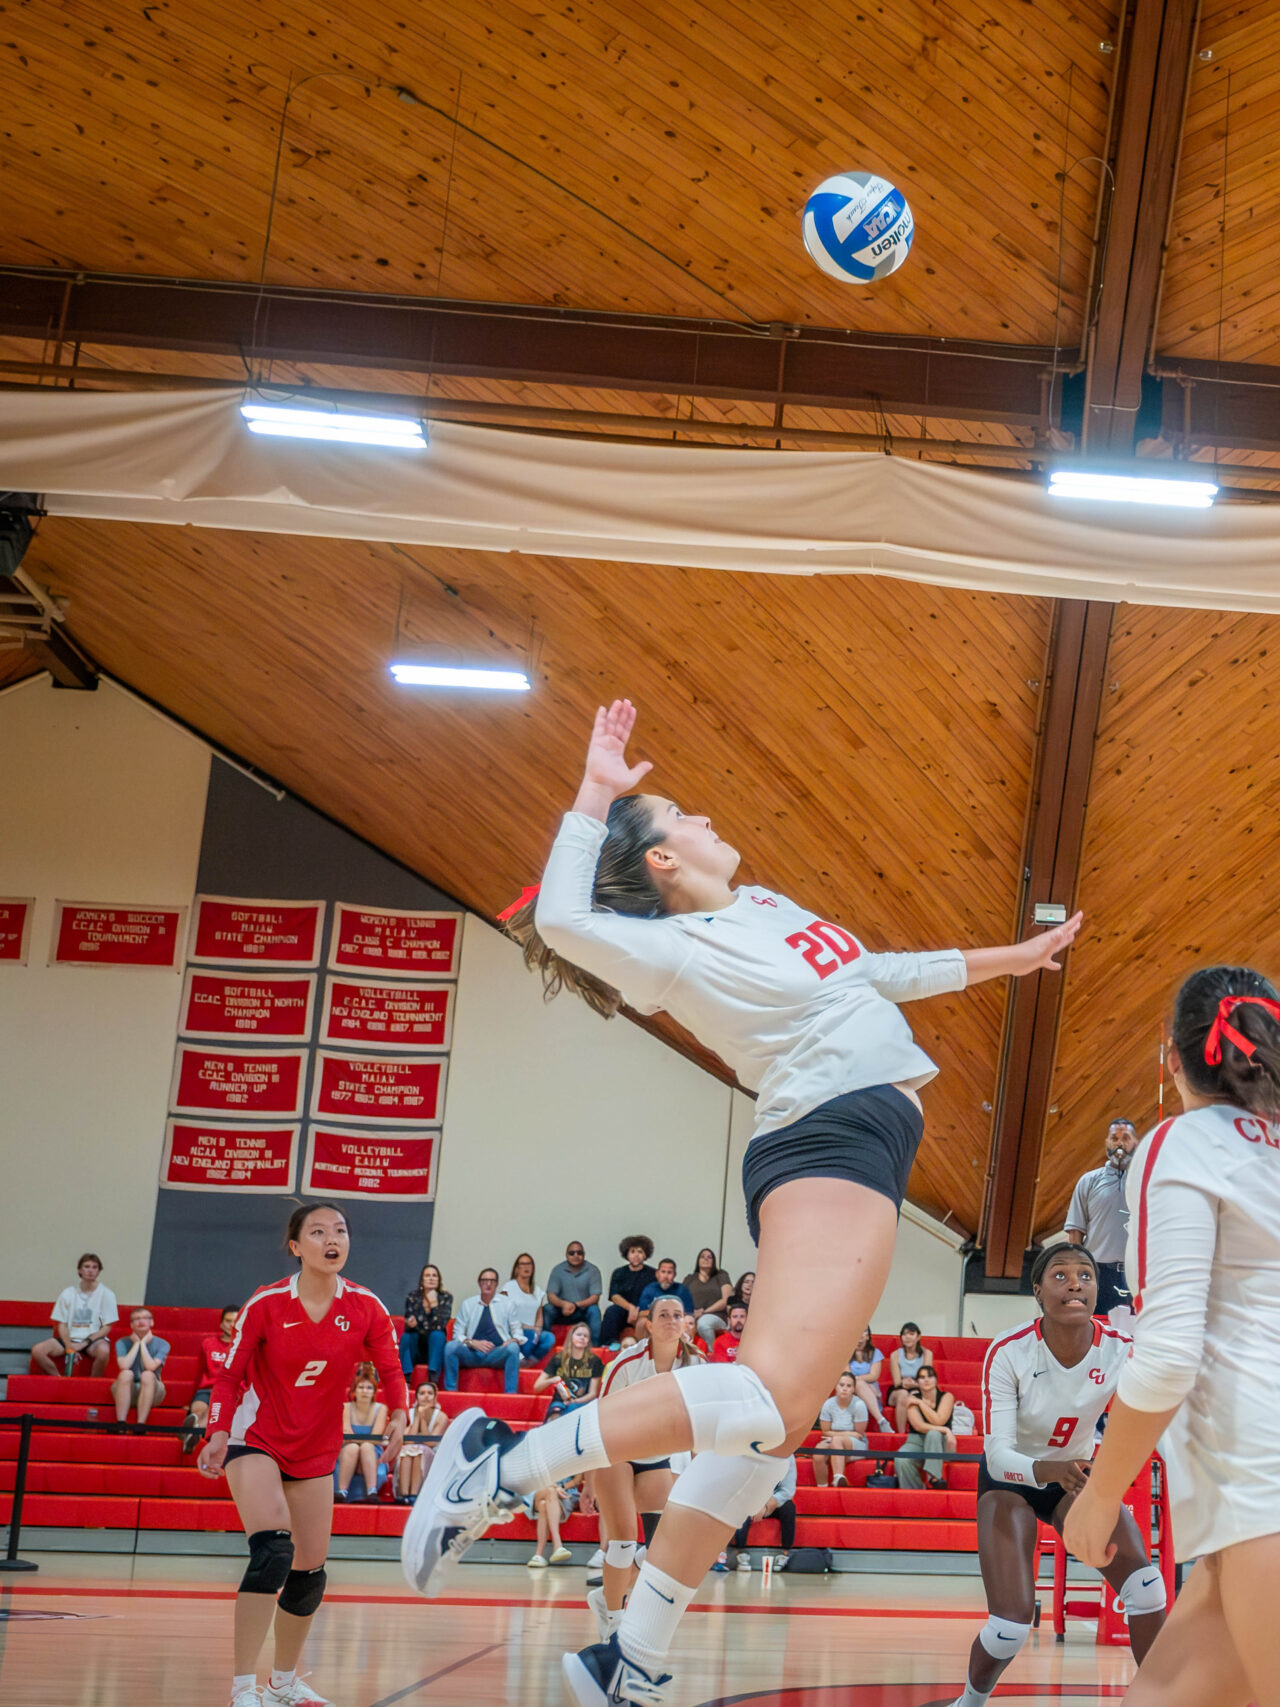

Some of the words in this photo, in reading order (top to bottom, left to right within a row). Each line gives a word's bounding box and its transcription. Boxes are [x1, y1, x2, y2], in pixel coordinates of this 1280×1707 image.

[863, 196, 901, 238] NCAA
[871, 211, 911, 256] molten
[127, 913, 165, 924] SOCCER
[231, 911, 283, 924] SOFTBALL
[112, 923, 151, 934] DIVISION
[88, 932, 149, 944] TOURNAMENT
[214, 931, 244, 942] STATE
[253, 934, 299, 944] CHAMPION
[386, 938, 394, 946] C
[784, 920, 861, 981] 20
[224, 986, 275, 997] SOFTBALL
[359, 988, 420, 1000] VOLLEYBALL
[225, 997, 260, 1007] DIVISION
[274, 998, 304, 1007] NORTH
[384, 1001, 421, 1010] DIVISION
[424, 1002, 434, 1011] III
[224, 1007, 270, 1018] CHAMPION
[331, 1007, 349, 1017] NEW
[351, 1009, 388, 1020] ENGLAND
[392, 1012, 443, 1022] TOURNAMENT
[243, 1063, 278, 1072] TENNIS
[349, 1062, 412, 1074] VOLLEYBALL
[231, 1072, 268, 1082] DIVISION
[209, 1081, 248, 1092] RUNNER
[253, 1083, 267, 1092] UP
[338, 1081, 367, 1092] STATE
[374, 1085, 420, 1095] CHAMPION
[235, 1138, 266, 1148] TENNIS
[224, 1149, 259, 1158] DIVISION
[341, 1144, 404, 1156] VOLLEYBALL
[172, 1155, 190, 1166] NEW
[192, 1157, 230, 1169] ENGLAND
[233, 1159, 287, 1169] SEMIFINALIST
[335, 1315, 350, 1331] CU
[294, 1360, 328, 1387] 2
[1088, 1368, 1105, 1385] CU
[1047, 1417, 1079, 1448] 9
